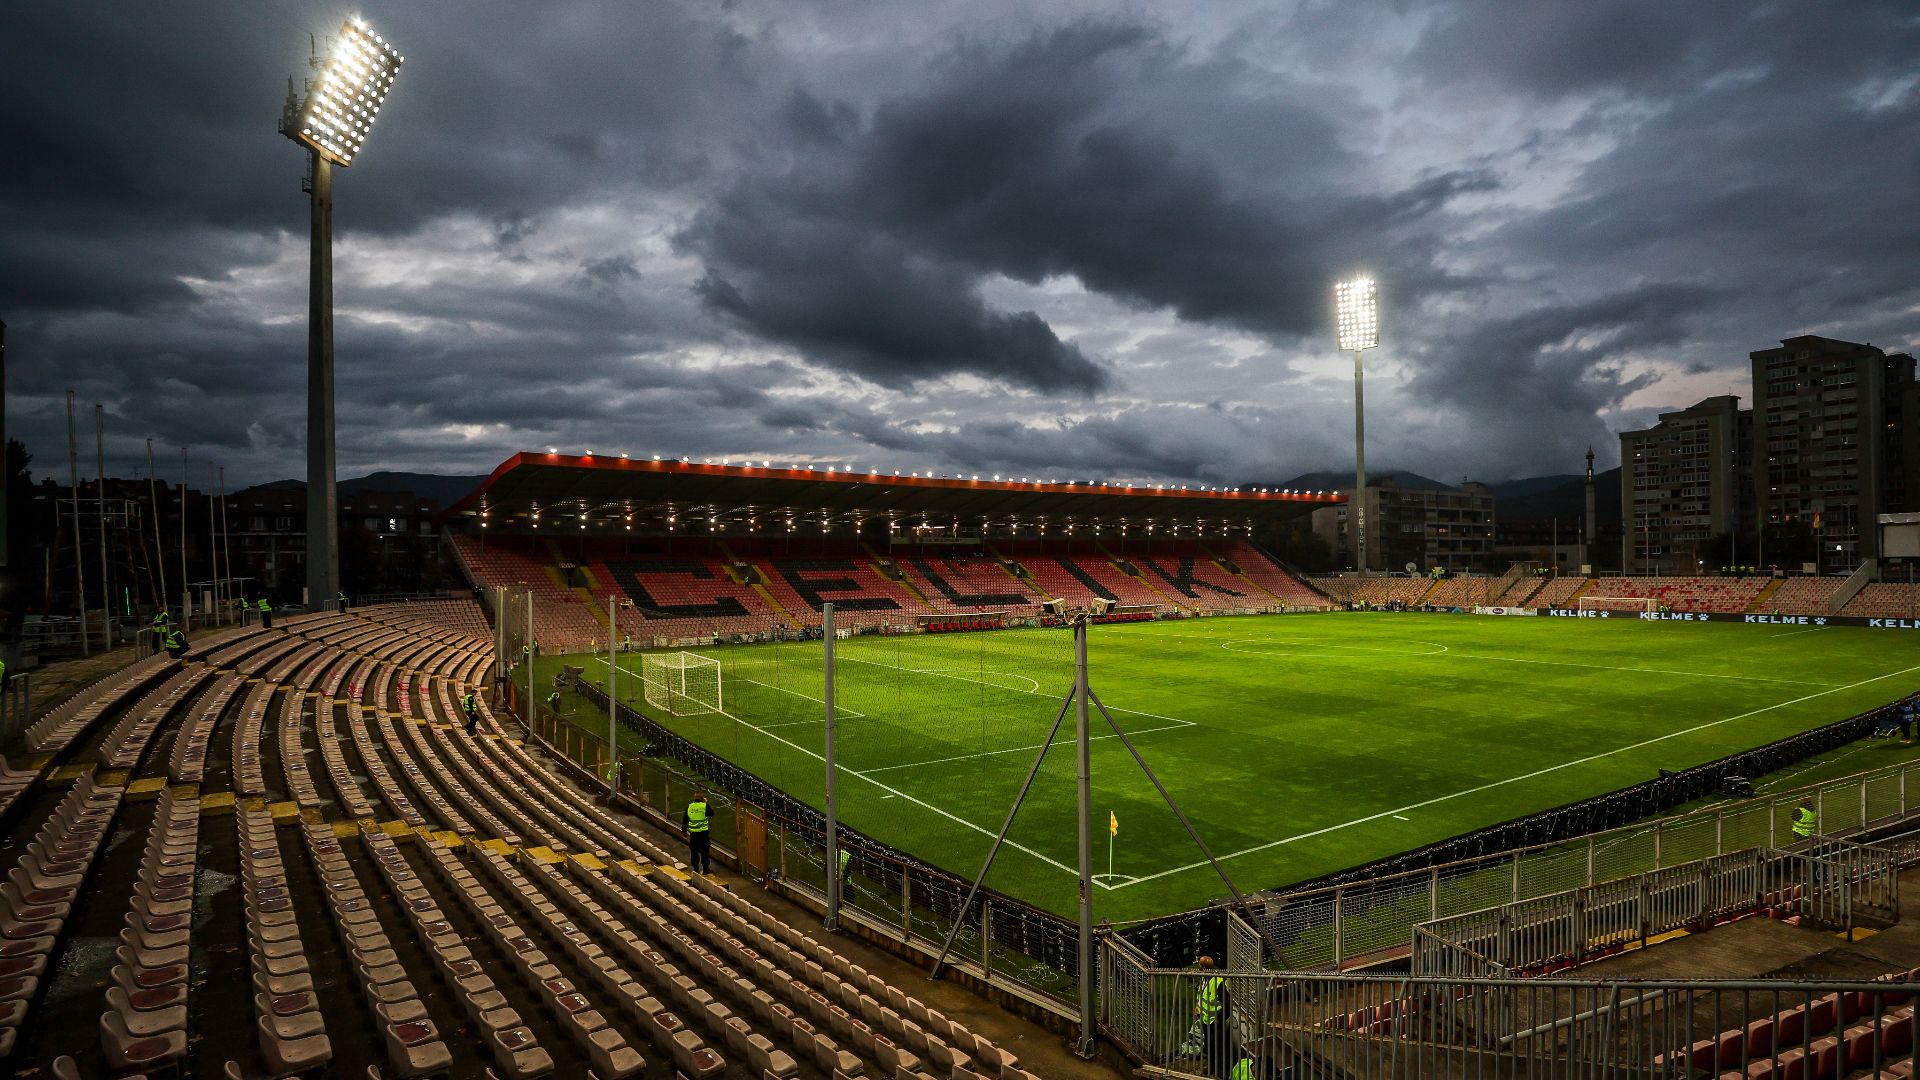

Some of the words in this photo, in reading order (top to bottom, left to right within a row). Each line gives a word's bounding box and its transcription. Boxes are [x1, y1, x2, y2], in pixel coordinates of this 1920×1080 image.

[1550, 609, 1596, 617] KELME
[1640, 611, 1694, 621] KELME
[1745, 614, 1809, 625] KELME
